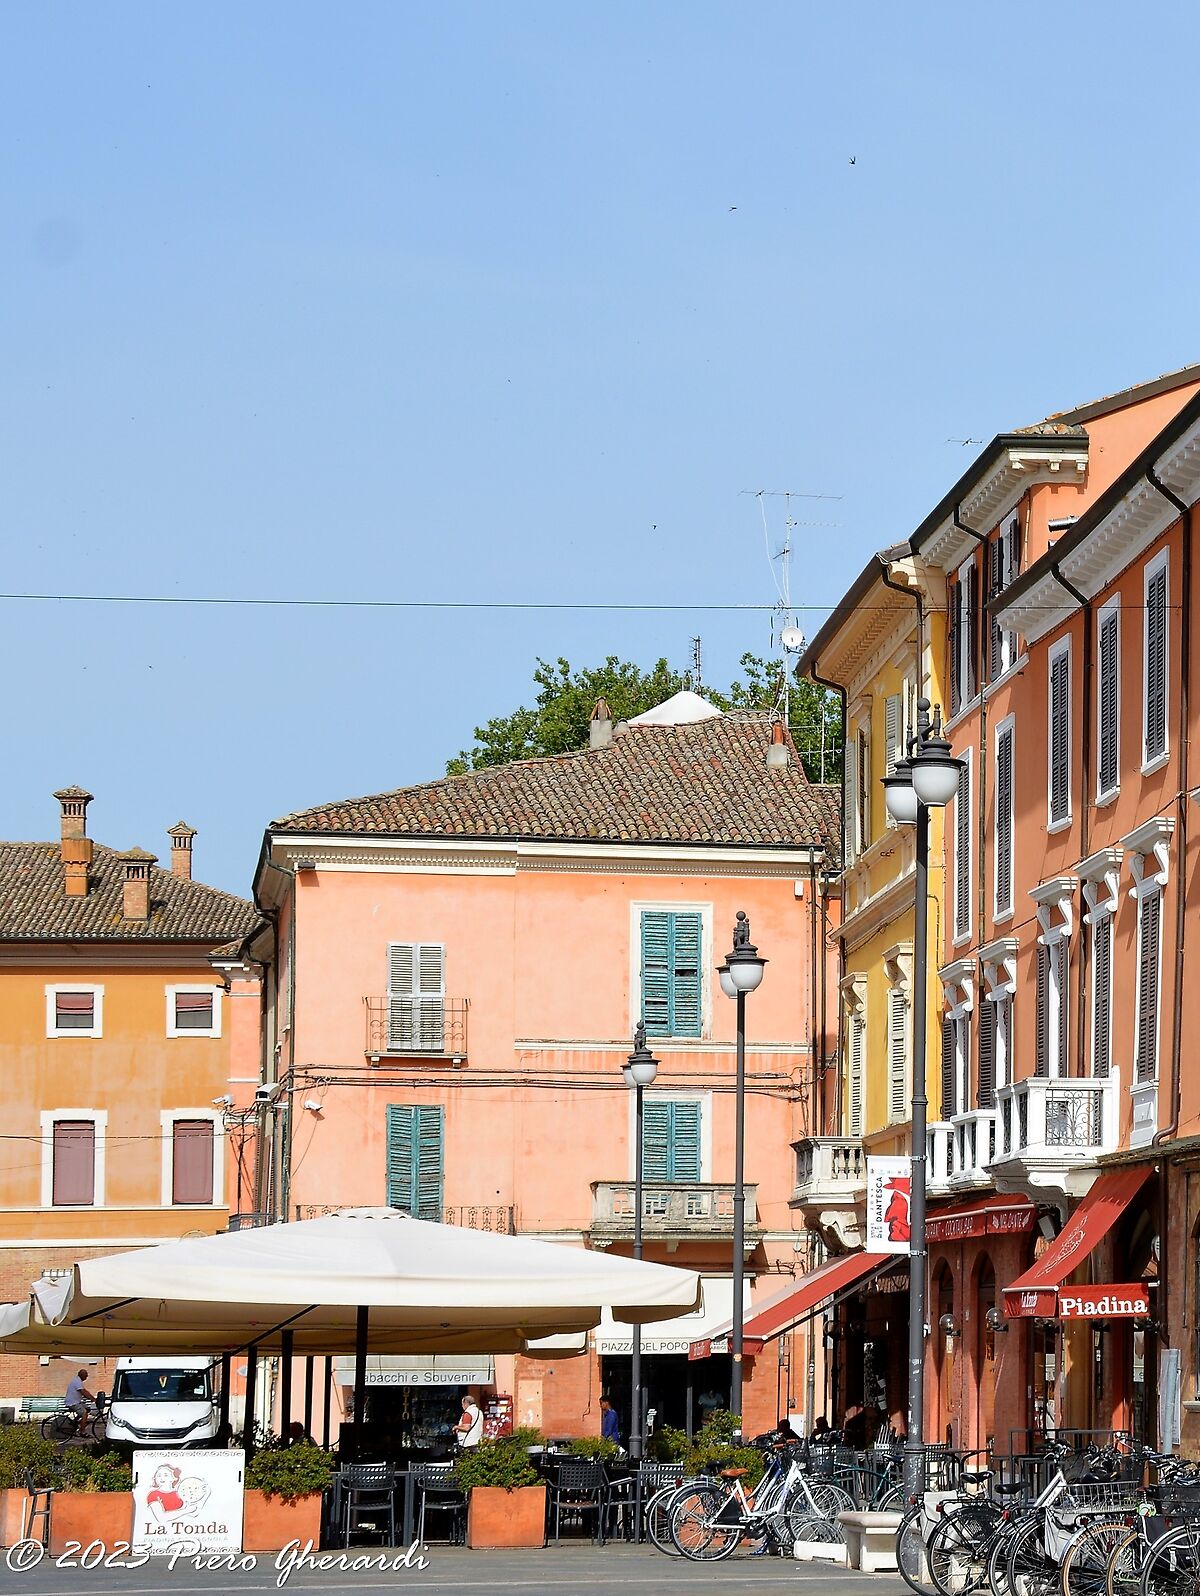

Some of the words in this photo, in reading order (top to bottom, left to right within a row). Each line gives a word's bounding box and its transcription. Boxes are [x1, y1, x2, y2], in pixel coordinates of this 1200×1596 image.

[1060, 1296, 1148, 1317] Piadina
[660, 1341, 689, 1351] POPO
[364, 1372, 408, 1383] abacchi
[411, 1375, 419, 1383] e
[424, 1371, 477, 1383] Souvenir
[144, 1522, 168, 1535] La
[171, 1521, 229, 1535] Tonda
